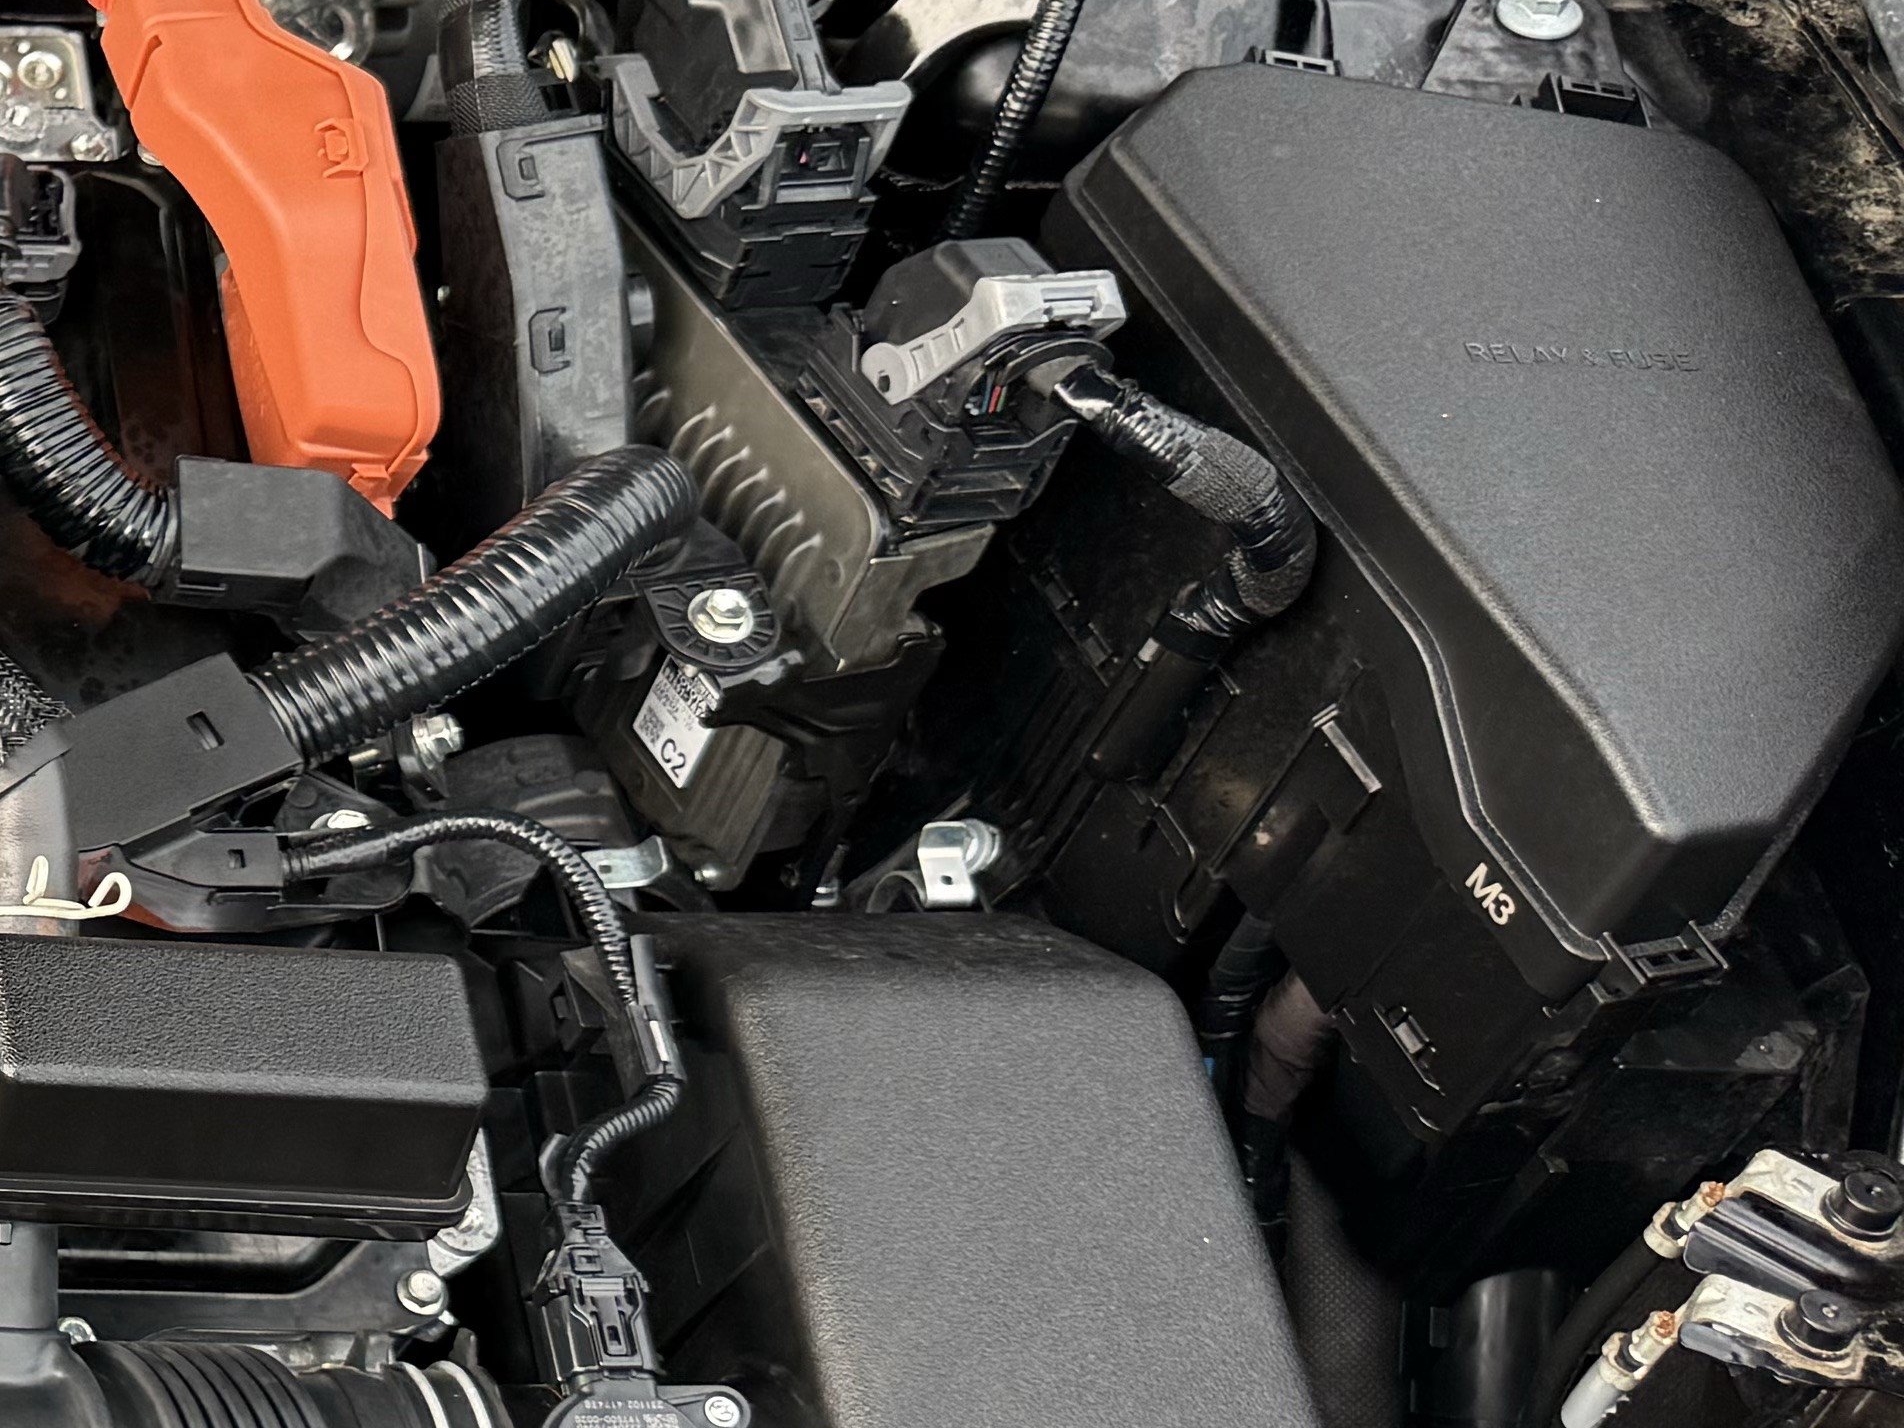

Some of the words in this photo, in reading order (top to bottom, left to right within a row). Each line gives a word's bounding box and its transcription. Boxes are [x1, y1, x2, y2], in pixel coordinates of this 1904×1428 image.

[1463, 341, 1569, 365] RELAY
[1606, 348, 1701, 372] FUSE
[660, 738, 686, 779] C2
[1465, 862, 1516, 926] M3
